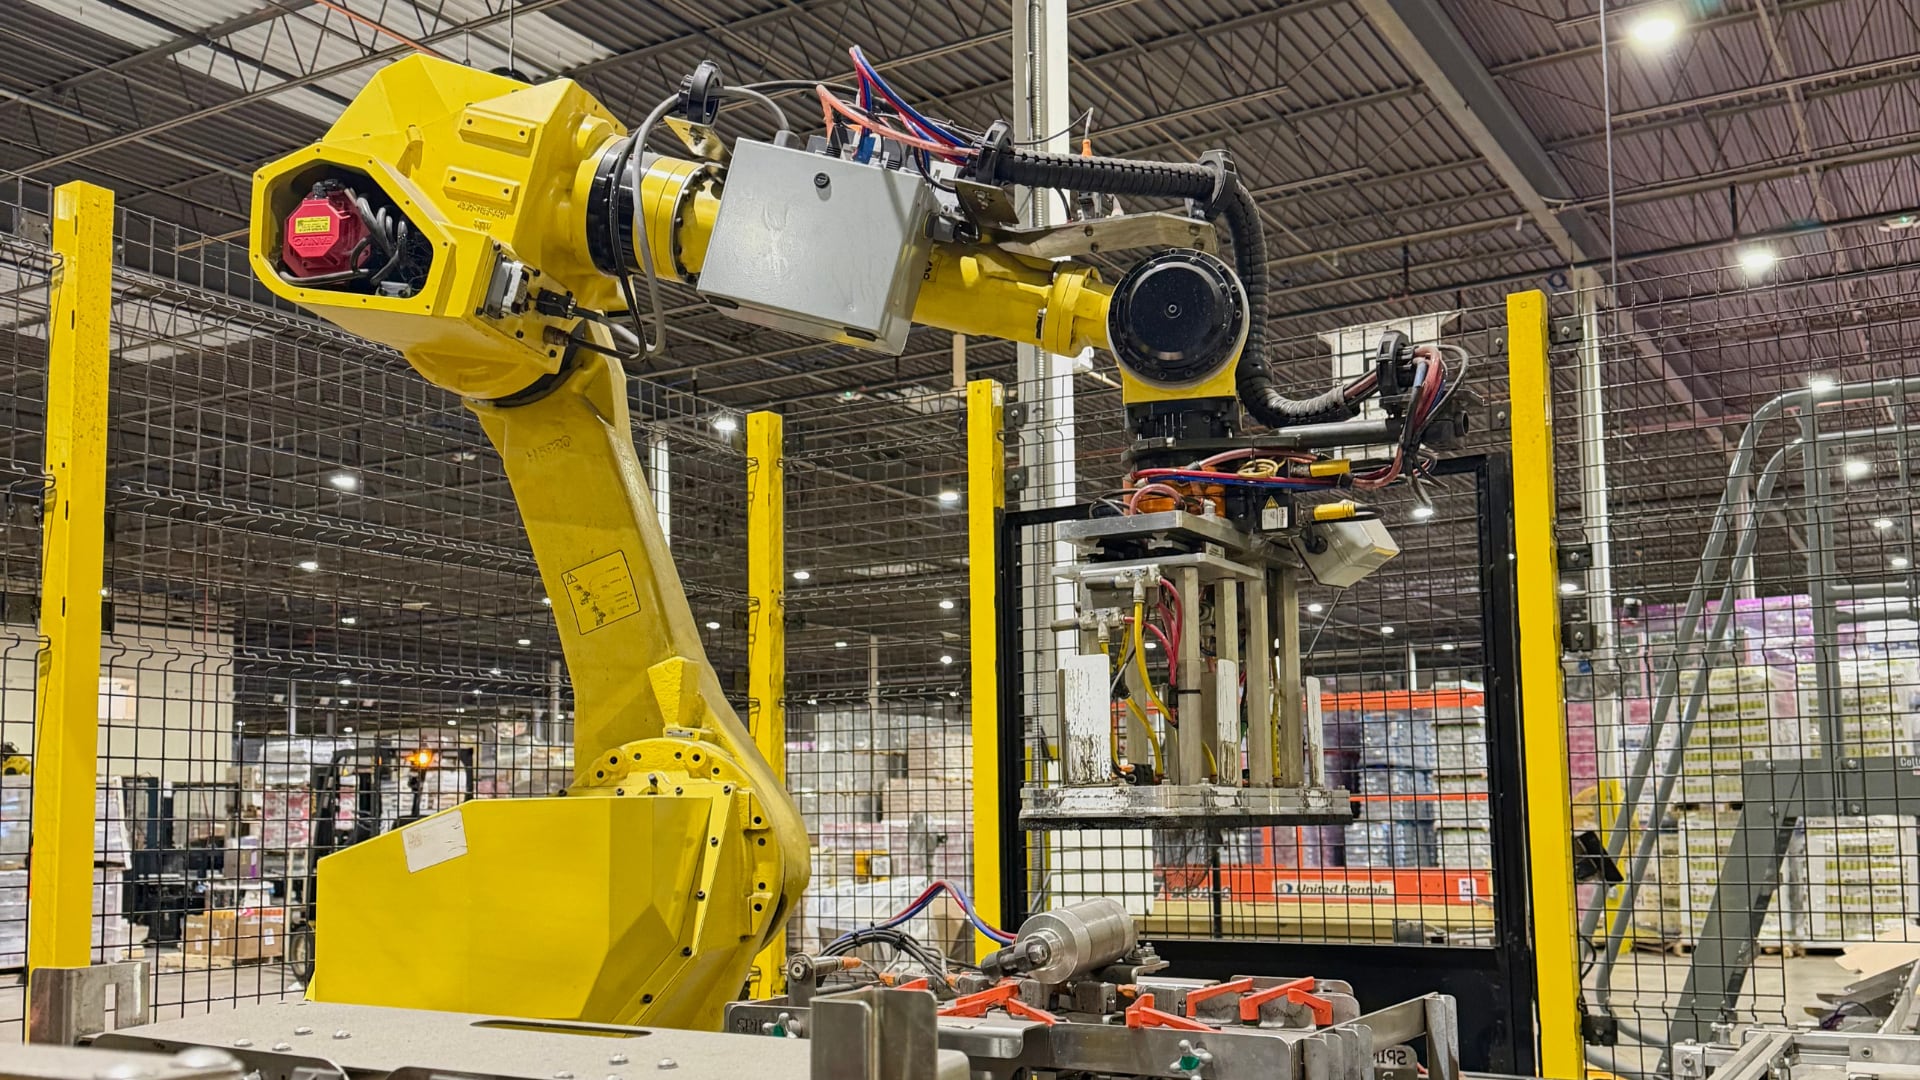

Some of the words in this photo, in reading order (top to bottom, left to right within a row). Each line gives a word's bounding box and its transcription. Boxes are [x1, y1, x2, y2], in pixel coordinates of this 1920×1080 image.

[292, 237, 332, 247] FANUC
[1297, 884, 1338, 895] United
[1341, 884, 1388, 896] Rentals
